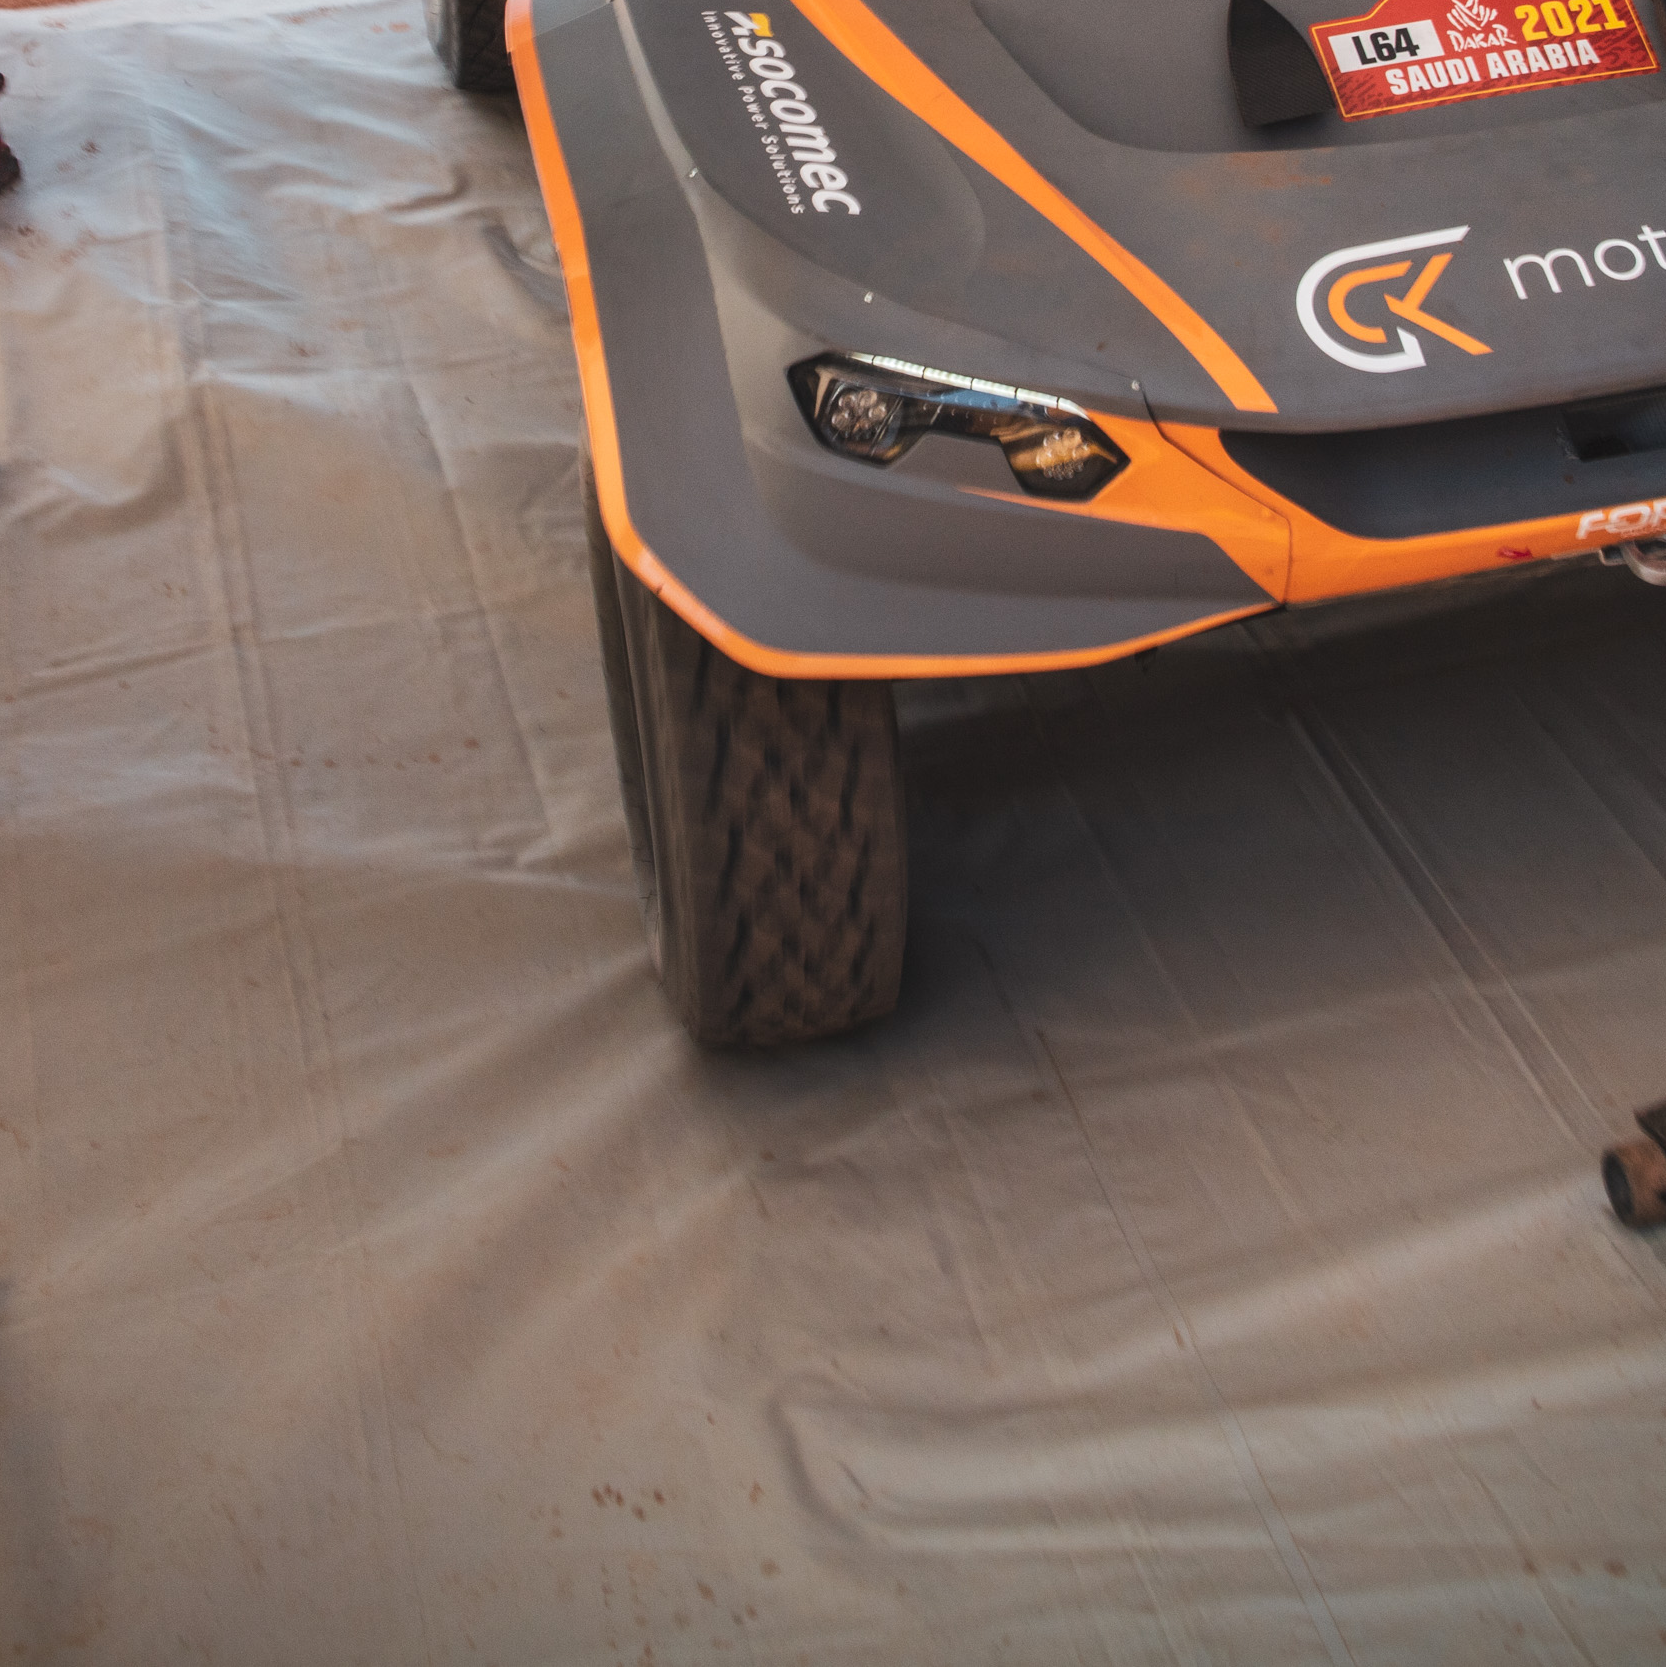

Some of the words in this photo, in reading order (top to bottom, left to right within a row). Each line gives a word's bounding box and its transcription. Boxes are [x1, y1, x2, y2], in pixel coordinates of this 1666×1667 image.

[1351, 27, 1420, 65] L64
[1446, 23, 1517, 53] DAKAR
[1385, 56, 1482, 96] SAUDI
[1486, 38, 1601, 80] ARABIA
[701, 10, 745, 81] Innovative
[738, 85, 770, 130] Power
[761, 134, 806, 215] Solutions
[737, 37, 862, 215] socomec
